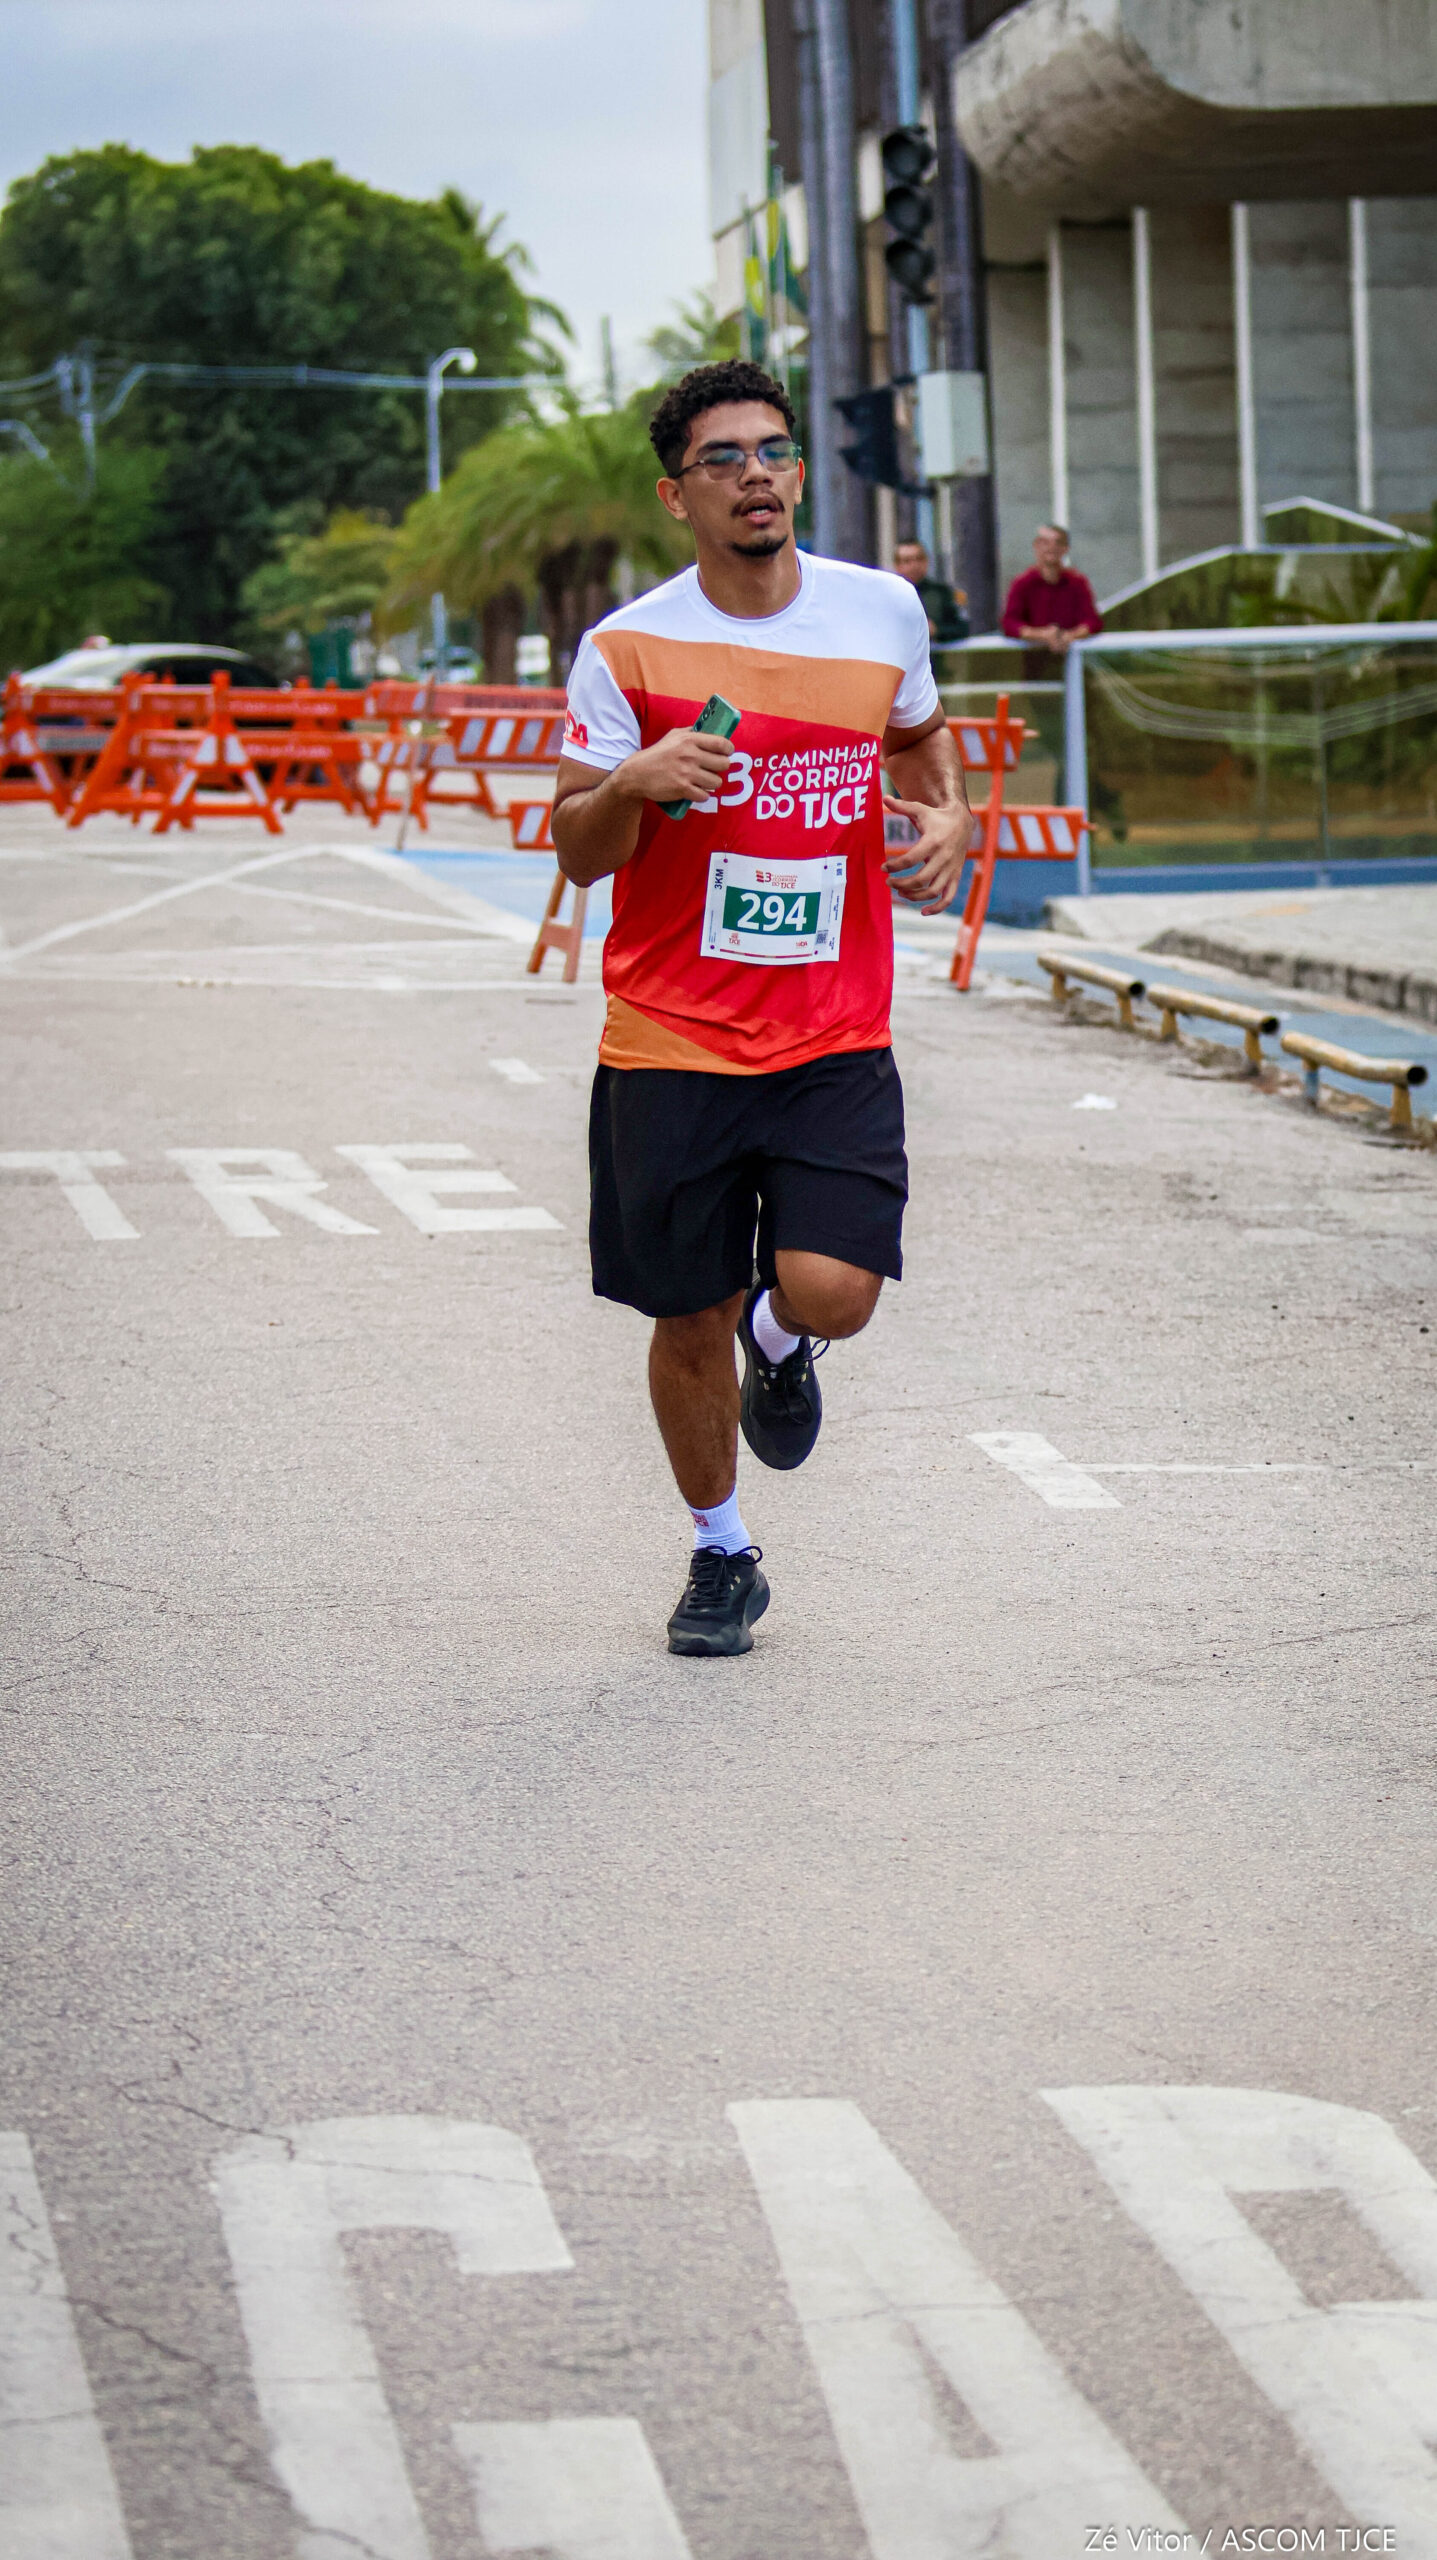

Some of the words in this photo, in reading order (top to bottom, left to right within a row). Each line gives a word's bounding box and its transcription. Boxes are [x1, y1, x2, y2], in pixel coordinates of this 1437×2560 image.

[768, 740, 878, 771] CAMINHADA
[757, 759, 873, 794] /CORRIDA
[756, 793, 795, 821] DO
[798, 785, 870, 829] TJCE
[714, 868, 724, 890] 3KM
[737, 892, 807, 932] 294
